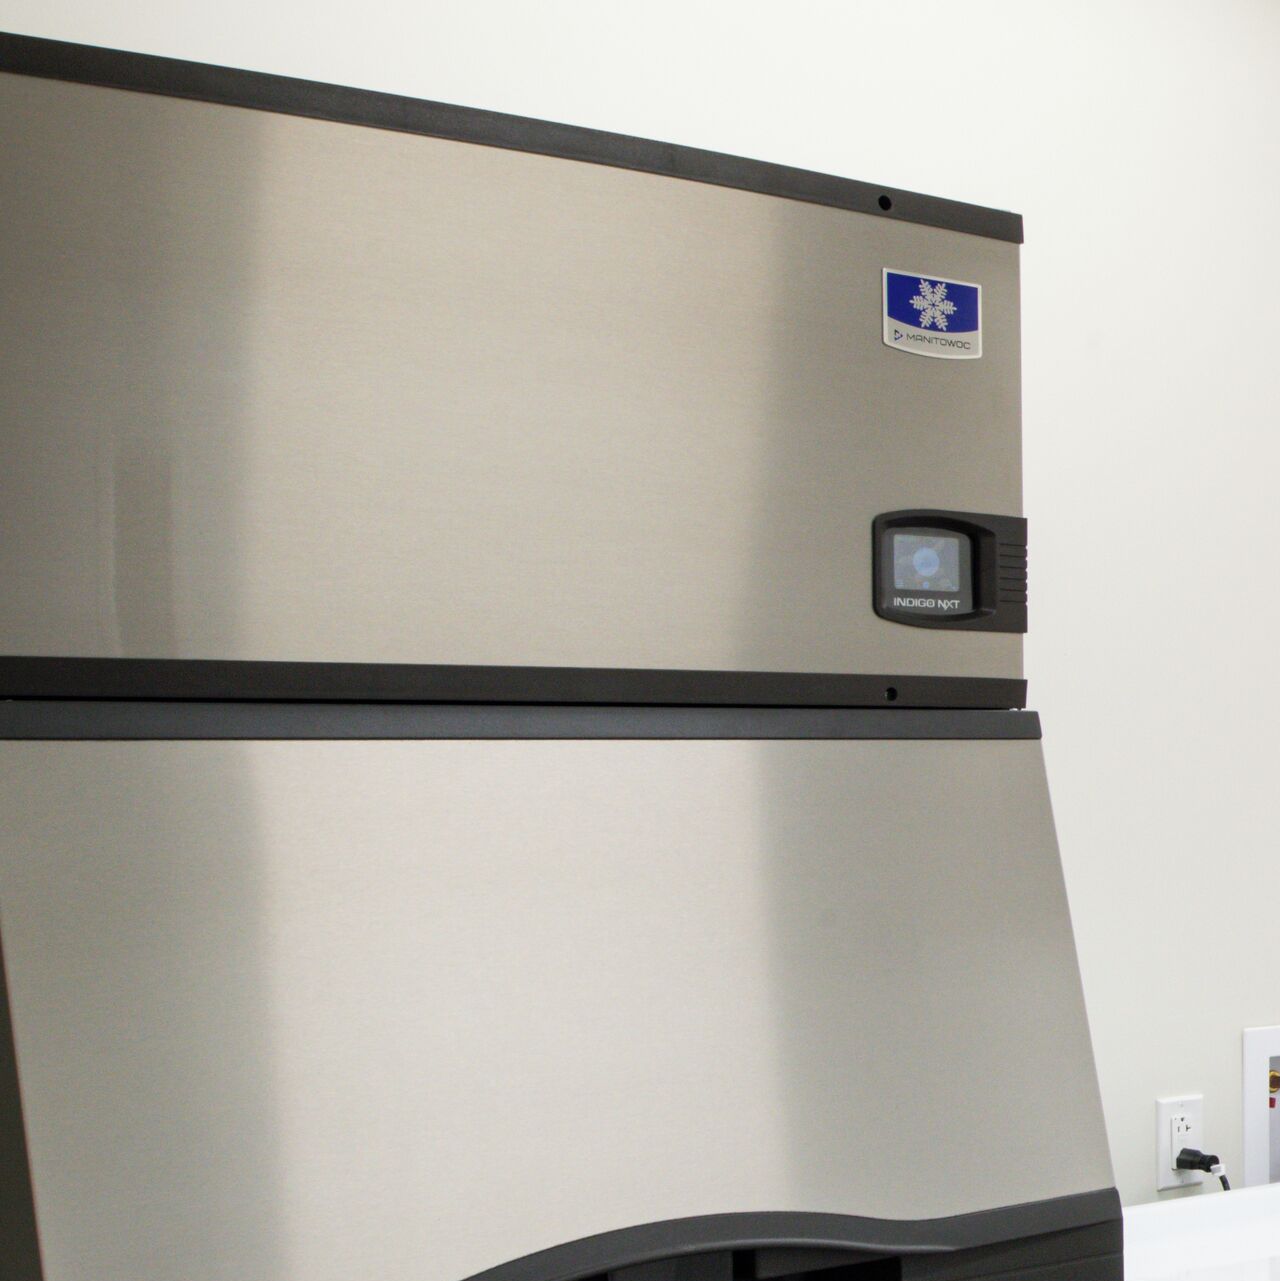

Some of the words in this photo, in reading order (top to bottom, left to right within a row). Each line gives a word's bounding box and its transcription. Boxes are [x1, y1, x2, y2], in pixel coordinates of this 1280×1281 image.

[906, 332, 972, 350] MANITOWOC
[893, 597, 935, 608] INDIGO
[937, 599, 960, 611] NXT
